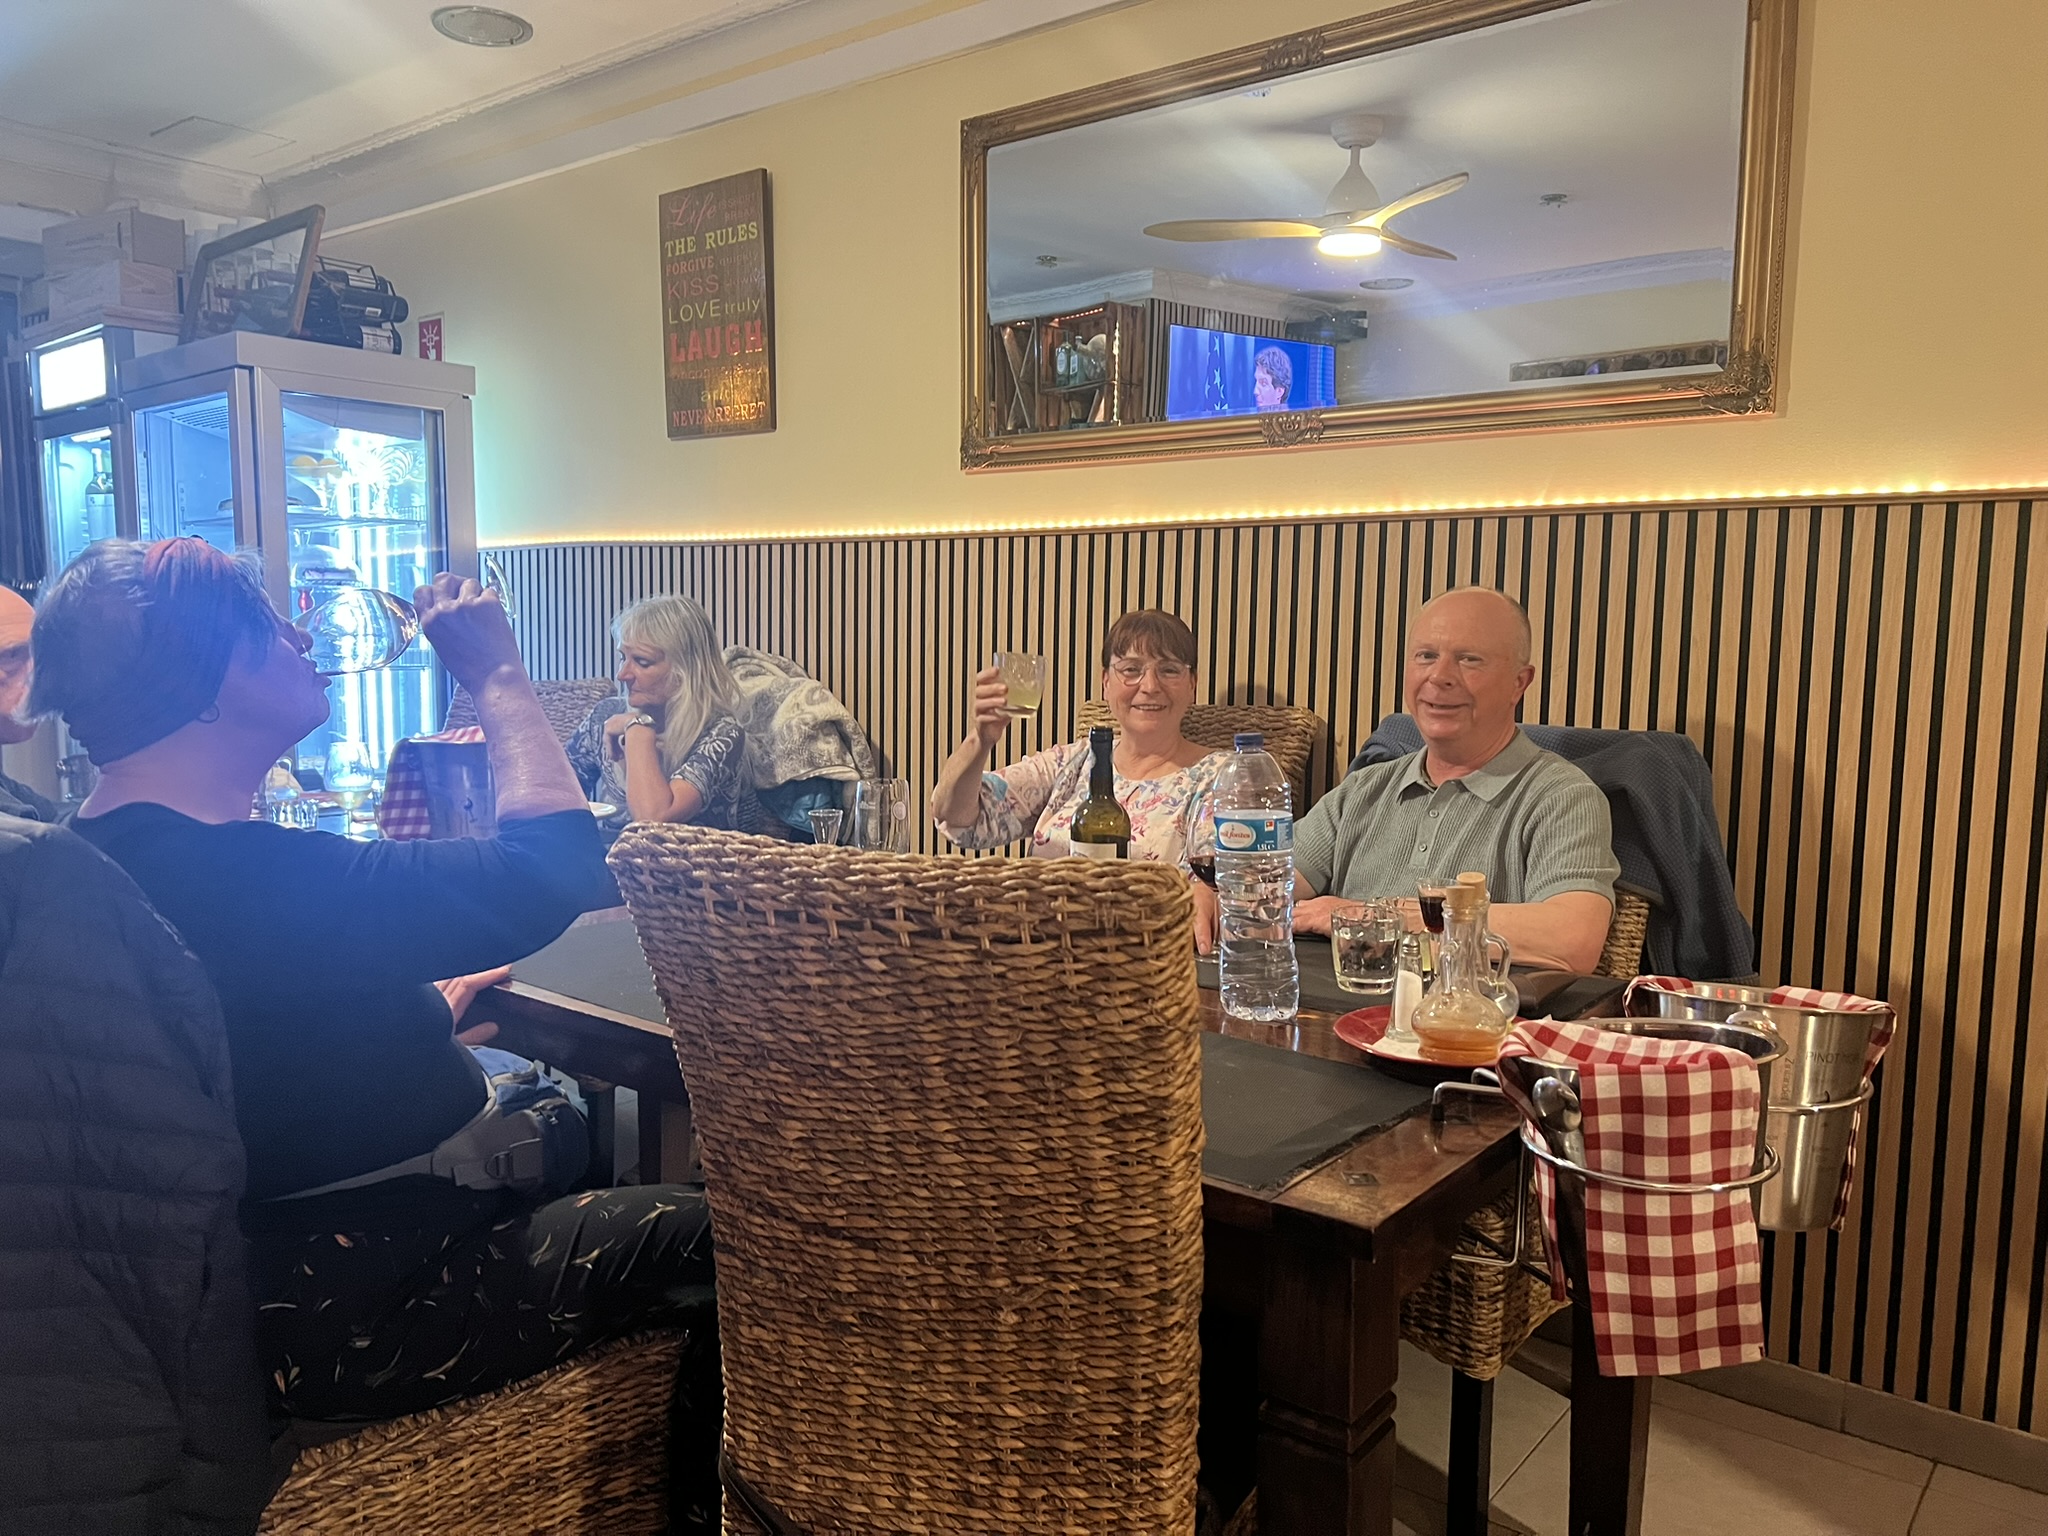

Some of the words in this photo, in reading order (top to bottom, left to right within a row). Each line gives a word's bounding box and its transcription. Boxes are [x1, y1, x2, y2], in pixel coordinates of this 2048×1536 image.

[668, 192, 716, 234] Life
[665, 236, 696, 257] THE
[705, 221, 758, 249] RULES
[666, 256, 715, 276] FORGIVE
[668, 274, 719, 299] KISS
[669, 299, 720, 324] LOVE
[725, 297, 760, 314] truly
[669, 319, 763, 362] LAUGH
[673, 408, 712, 427] NEVER
[715, 401, 766, 421] REGRET
[1806, 1051, 1840, 1064] PINOT
